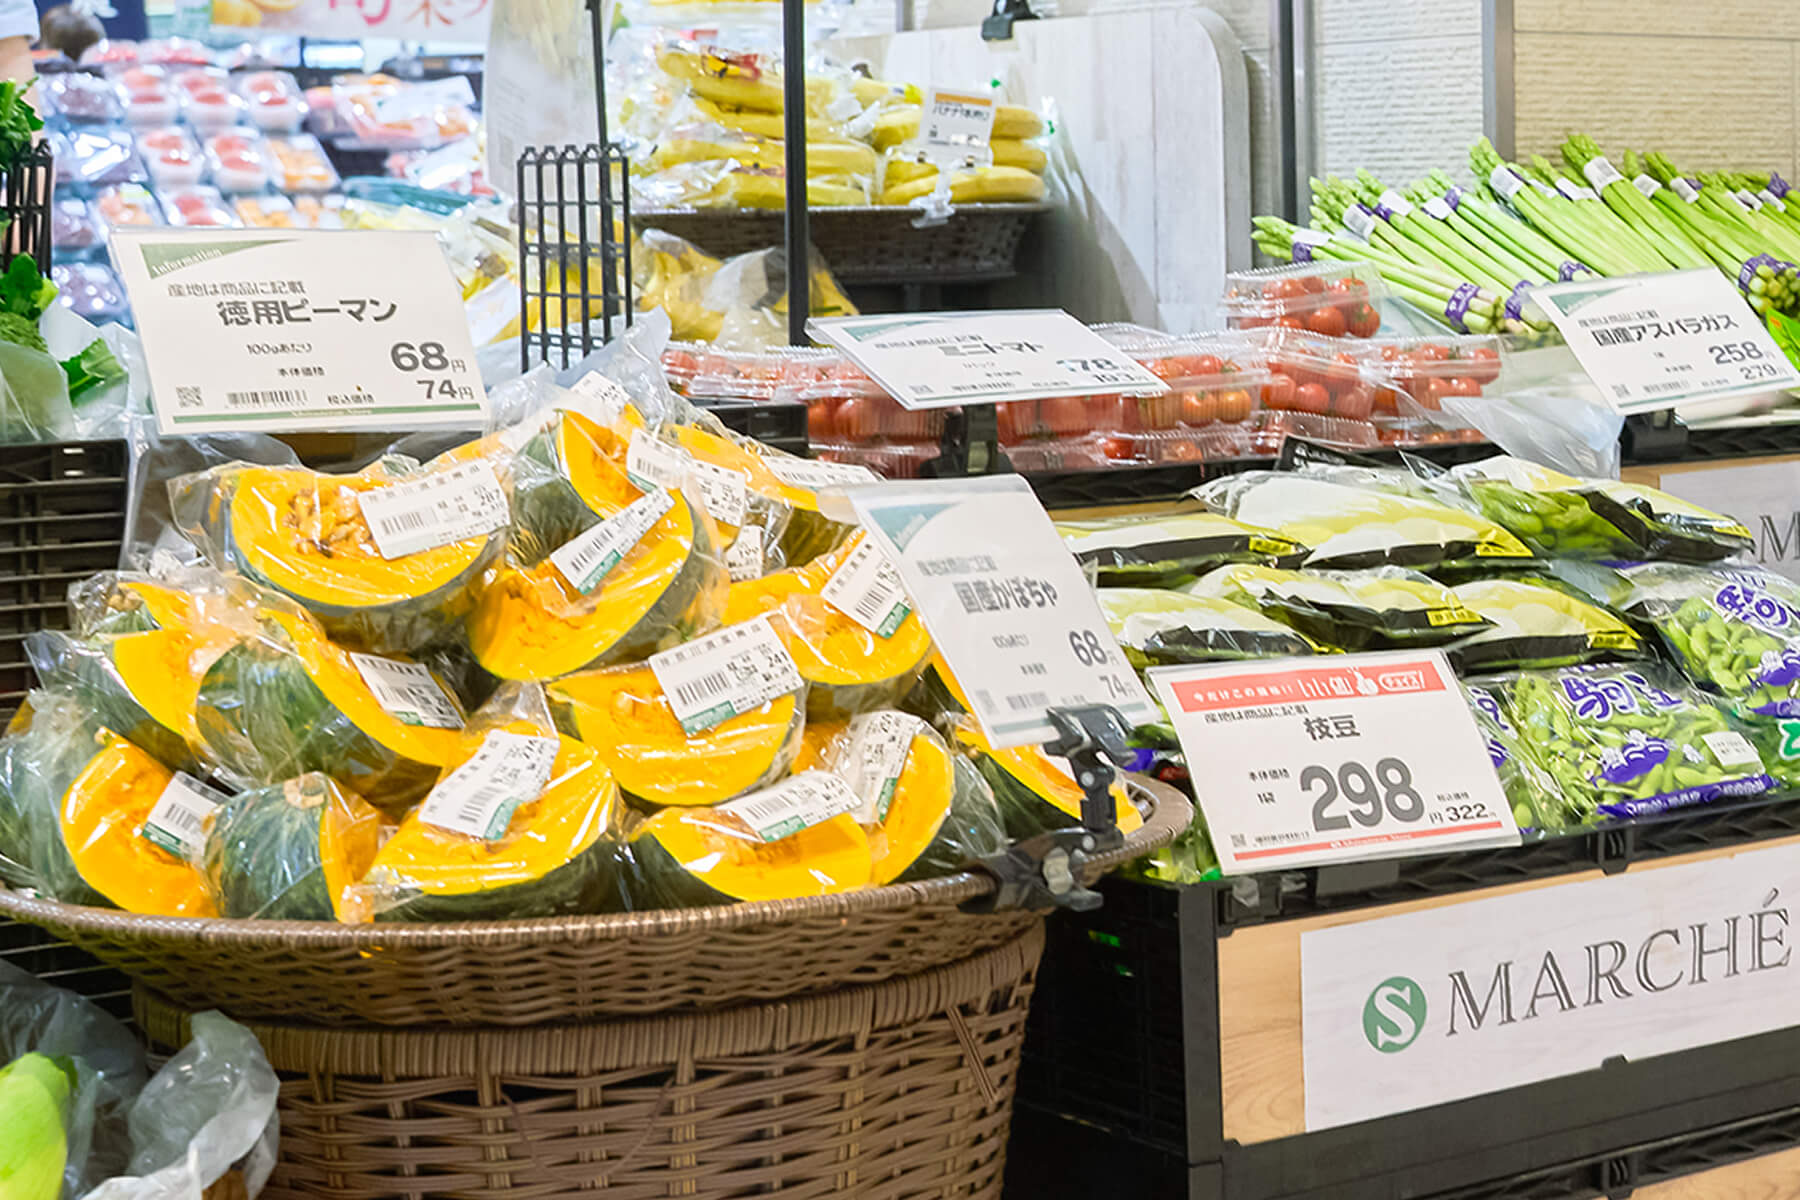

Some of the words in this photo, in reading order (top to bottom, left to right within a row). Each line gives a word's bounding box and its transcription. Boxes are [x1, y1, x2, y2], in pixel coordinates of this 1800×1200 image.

[215, 298, 397, 327] 徳用ピーマン
[1590, 313, 1739, 347] 国産アスパラガス
[1707, 340, 1765, 365] 258
[1739, 363, 1778, 381] 279
[952, 574, 1059, 615] 国産かぼちゃ
[1303, 714, 1361, 741] 枝豆
[1299, 756, 1425, 833] 298
[1371, 982, 1418, 1051] S
[1445, 886, 1793, 1037] MARCHÉ
